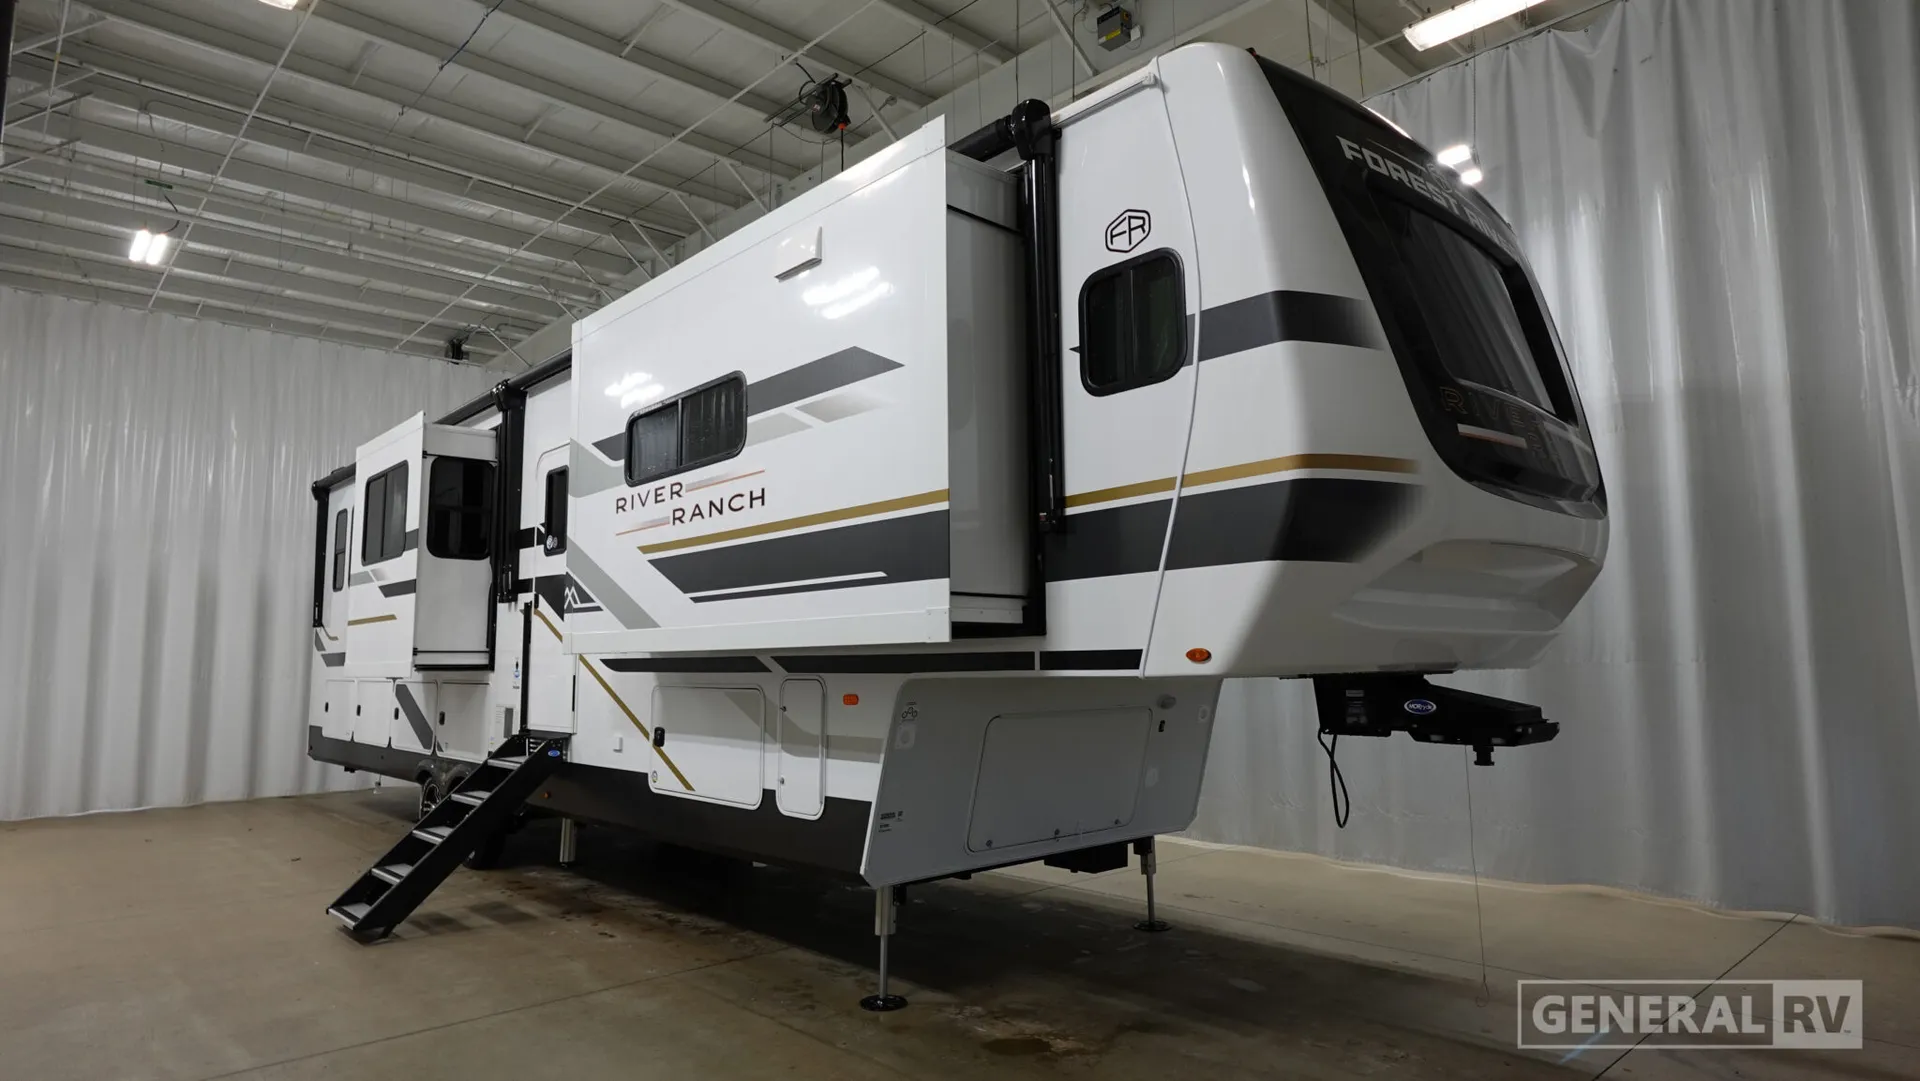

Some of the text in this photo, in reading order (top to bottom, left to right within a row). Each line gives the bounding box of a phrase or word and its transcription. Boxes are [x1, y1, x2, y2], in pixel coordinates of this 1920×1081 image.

[1336, 135, 1460, 215] FOREST
[1109, 215, 1146, 246] FR
[615, 481, 684, 514] RIVER
[671, 487, 766, 526] RANCH
